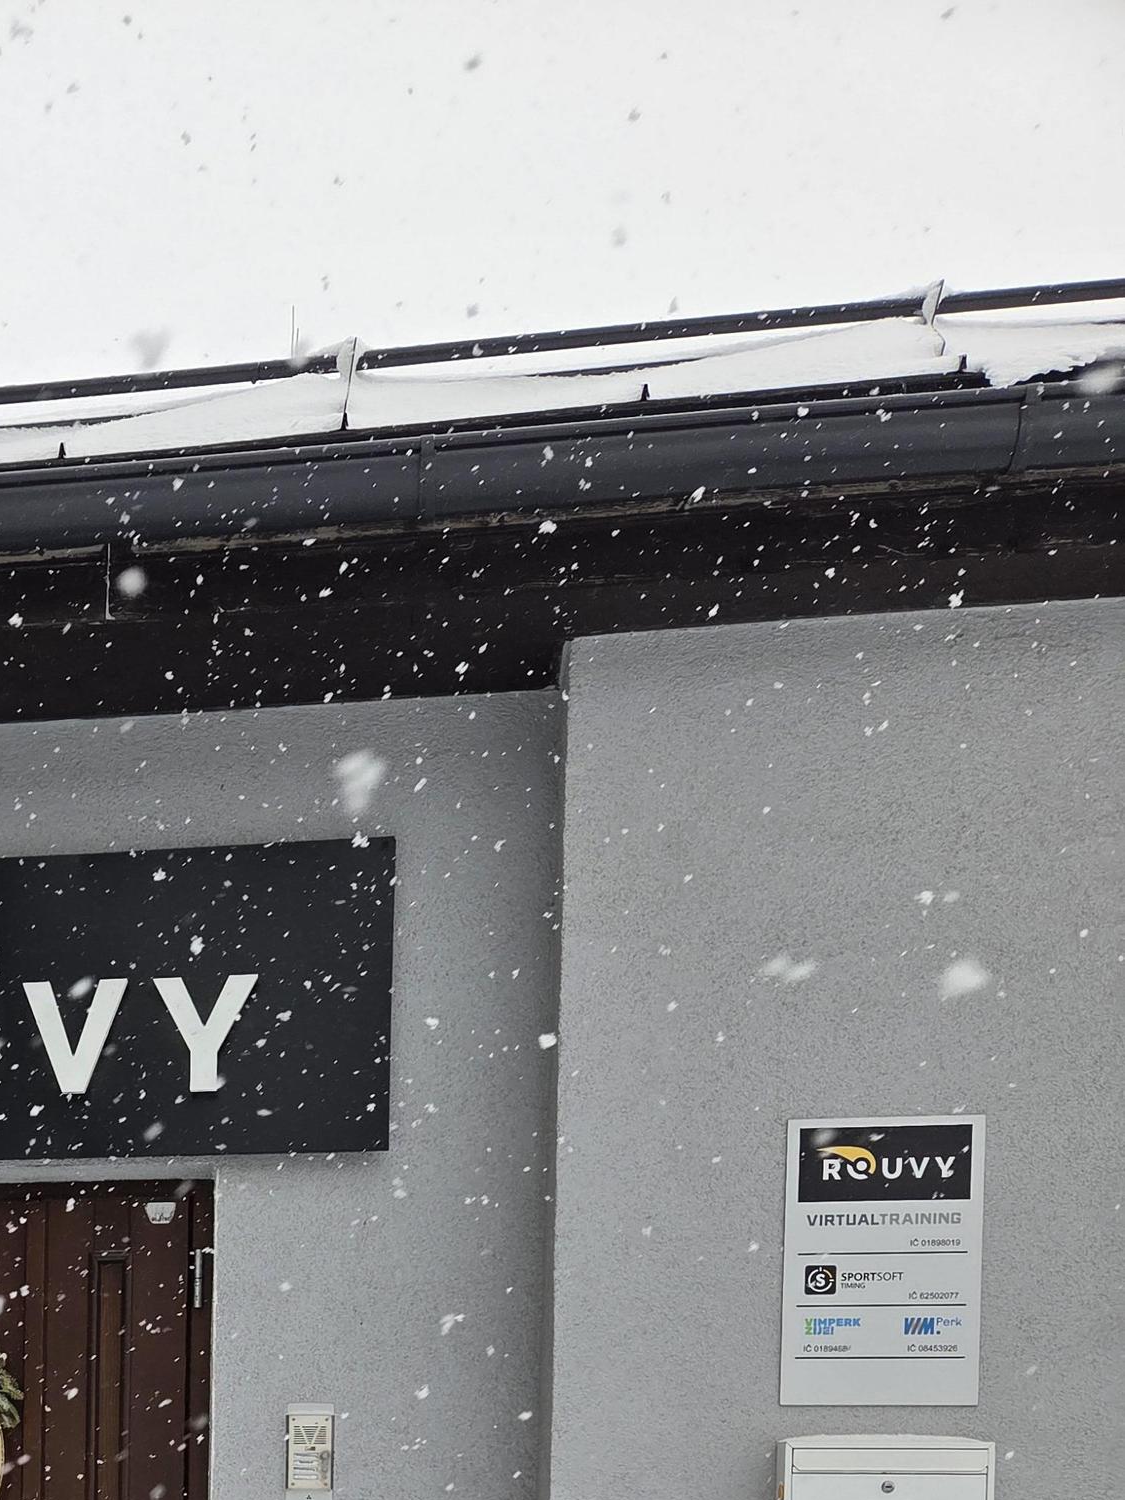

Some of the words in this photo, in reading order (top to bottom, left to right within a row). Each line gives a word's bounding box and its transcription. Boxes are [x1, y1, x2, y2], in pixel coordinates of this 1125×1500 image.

[822, 1152, 956, 1181] ROUVY
[806, 1212, 962, 1226] VIRTUALTRAINING
[841, 1271, 904, 1282] SPORTSOFT
[805, 1317, 861, 1327] VIMPERK
